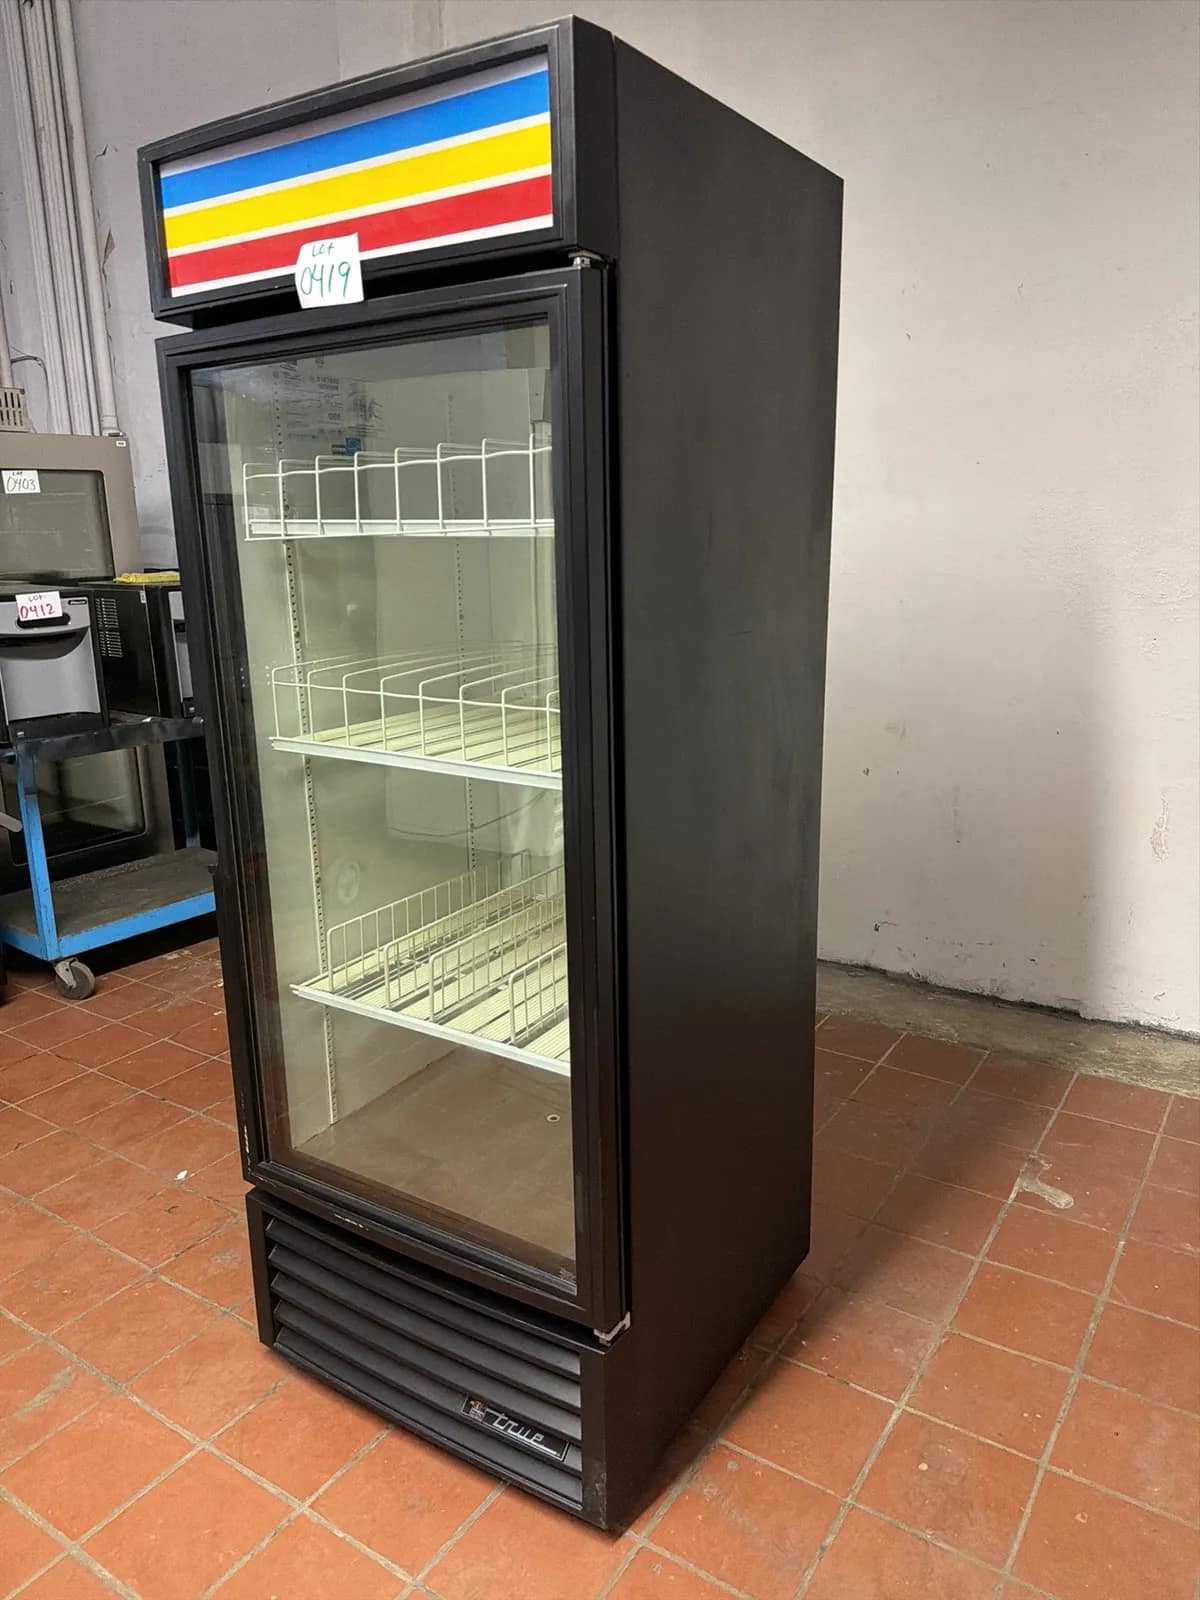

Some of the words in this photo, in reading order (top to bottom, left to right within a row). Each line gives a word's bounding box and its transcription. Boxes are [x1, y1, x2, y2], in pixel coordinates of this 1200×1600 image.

[300, 260, 351, 298] 0419
[6, 476, 37, 492] 0403
[20, 603, 56, 619] 0412
